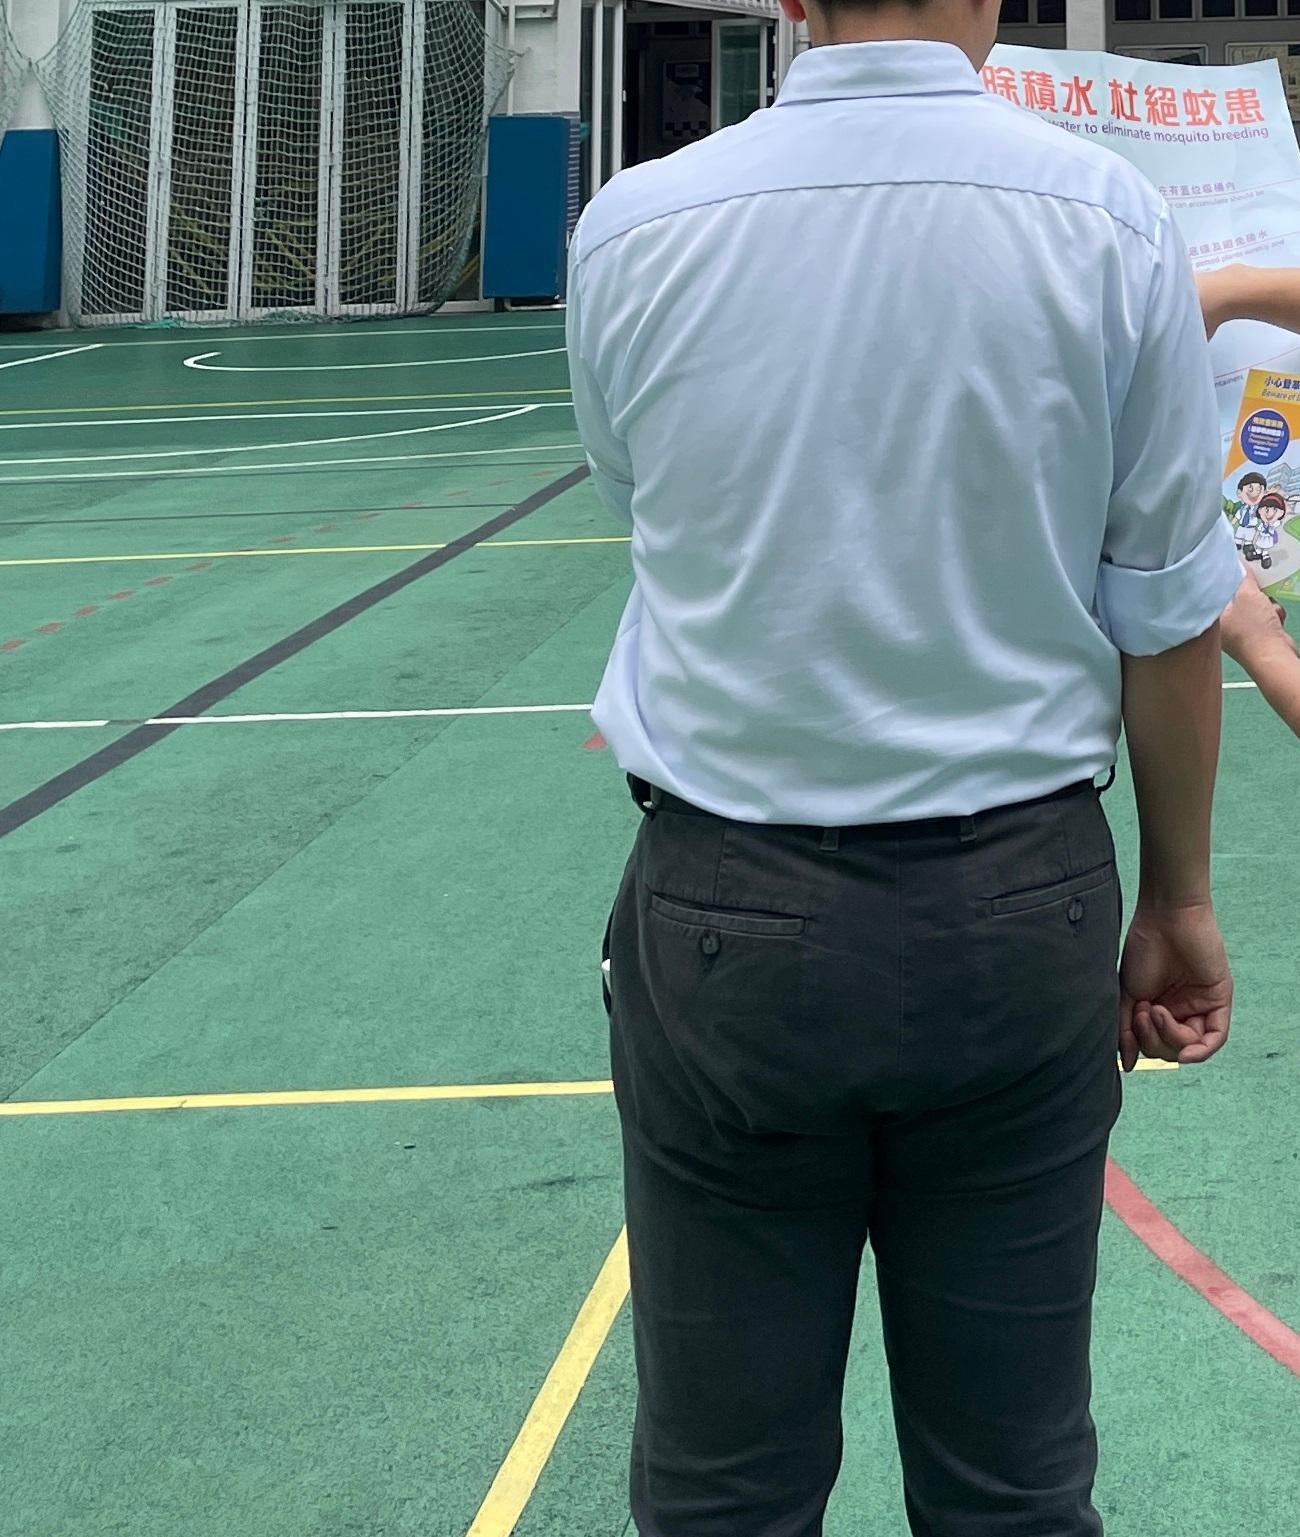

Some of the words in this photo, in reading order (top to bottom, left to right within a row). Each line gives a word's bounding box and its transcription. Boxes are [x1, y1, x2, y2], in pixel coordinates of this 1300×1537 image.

[1107, 78, 1266, 128] 杜絕蚊患
[1084, 122, 1098, 135] to
[1101, 123, 1152, 141] eliminate
[1153, 131, 1211, 146] mosquito
[1212, 126, 1269, 142] breeding
